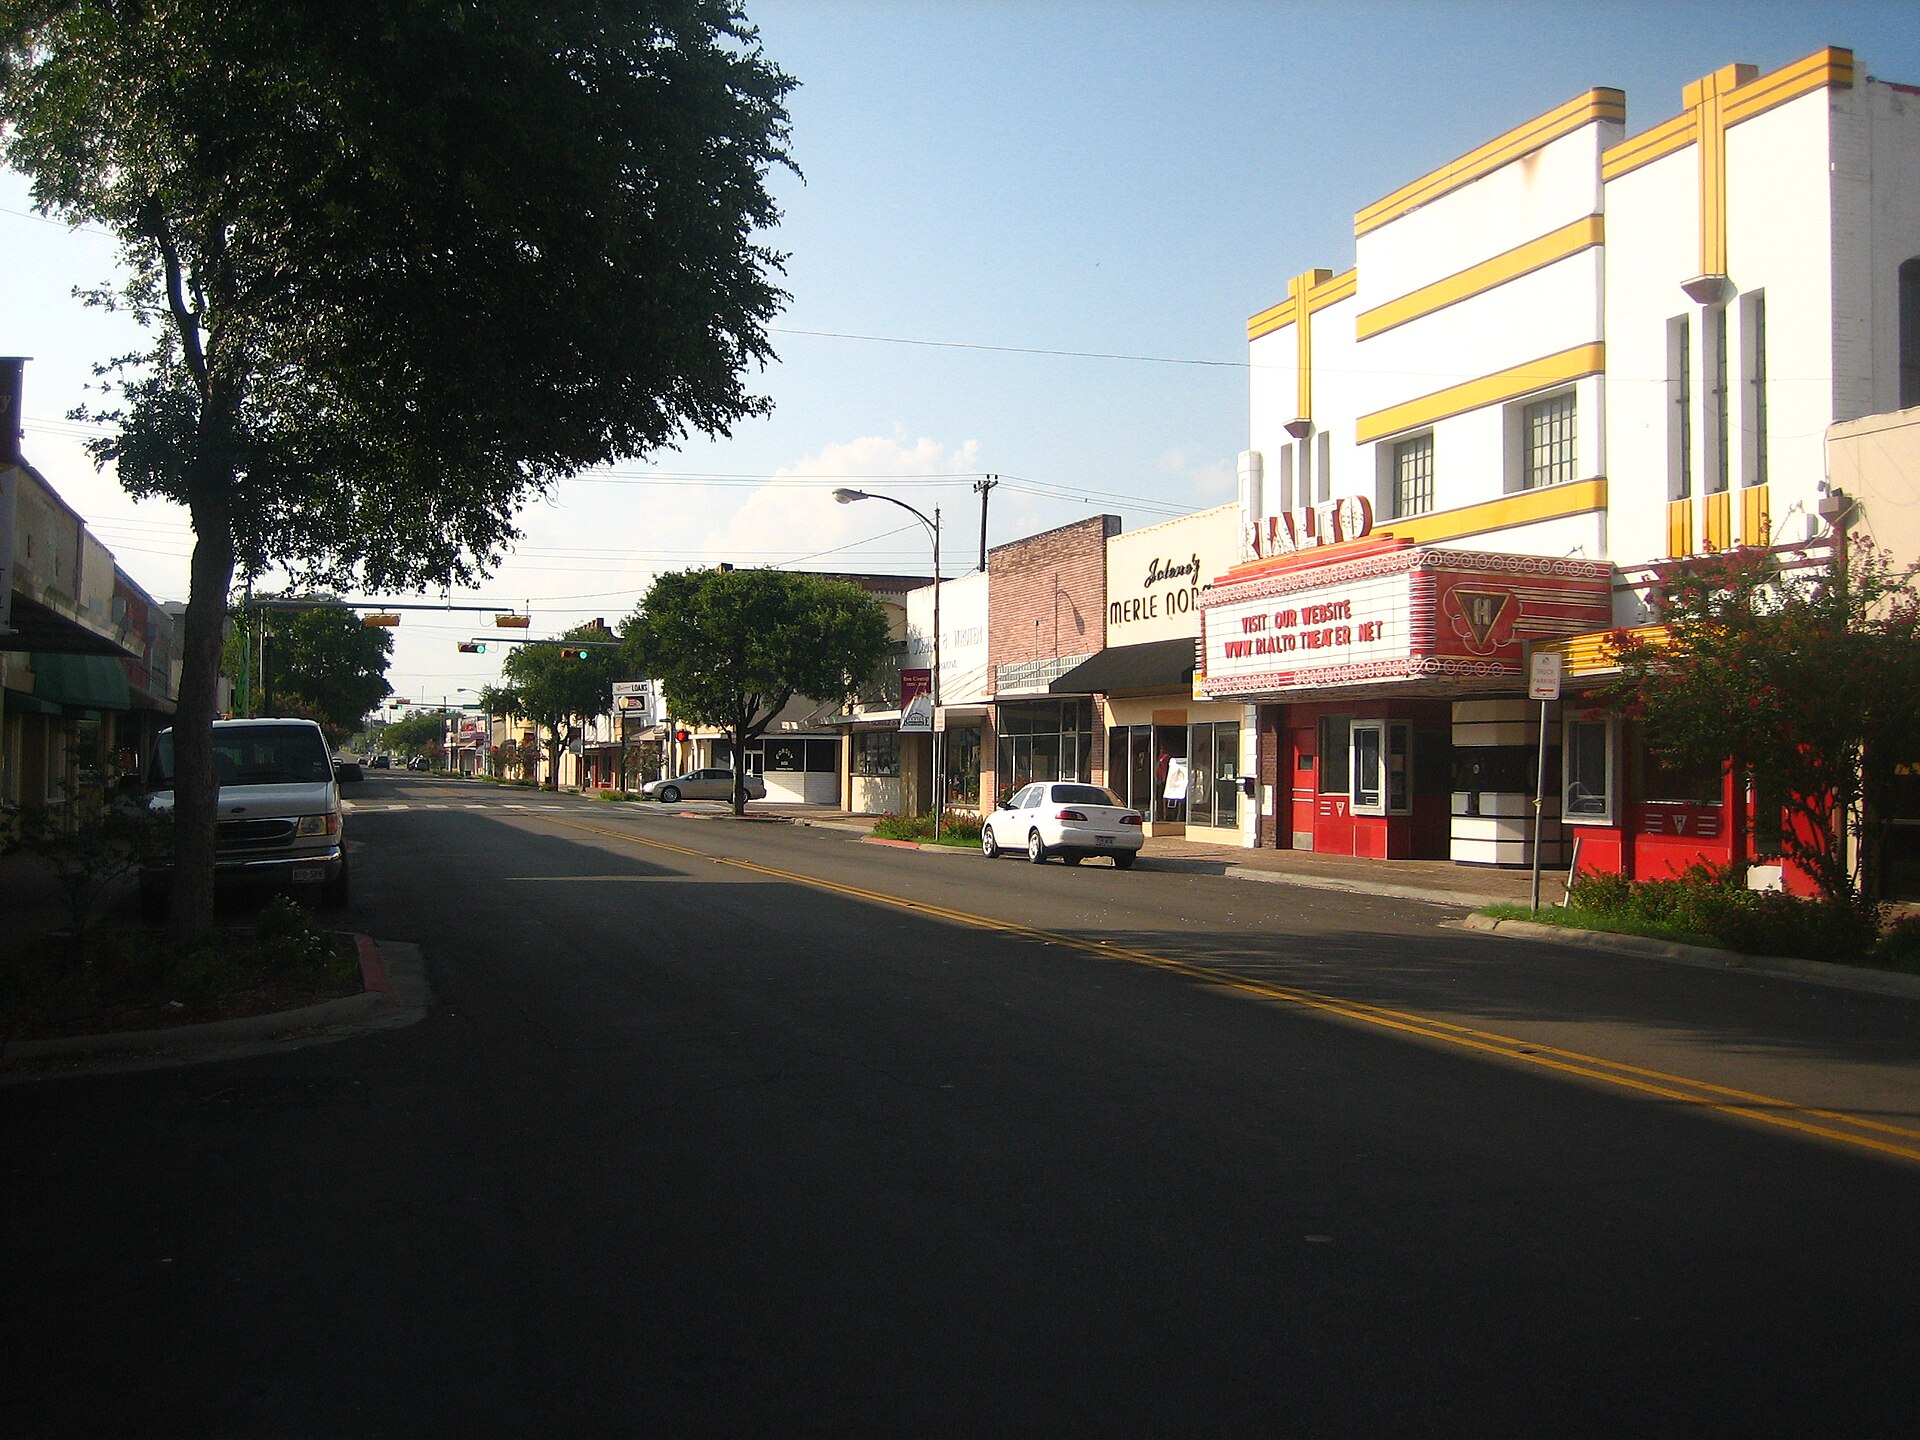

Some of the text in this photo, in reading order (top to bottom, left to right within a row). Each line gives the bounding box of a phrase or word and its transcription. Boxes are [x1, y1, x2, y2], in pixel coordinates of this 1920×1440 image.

[1241, 495, 1373, 563] RIALTO
[1110, 584, 1211, 625] MERLE NOR
[1241, 599, 1352, 634] VISIT OUR WEBSITE
[1473, 598, 1491, 625] H
[1224, 620, 1383, 659] WWW RIALTO THEATER NET
